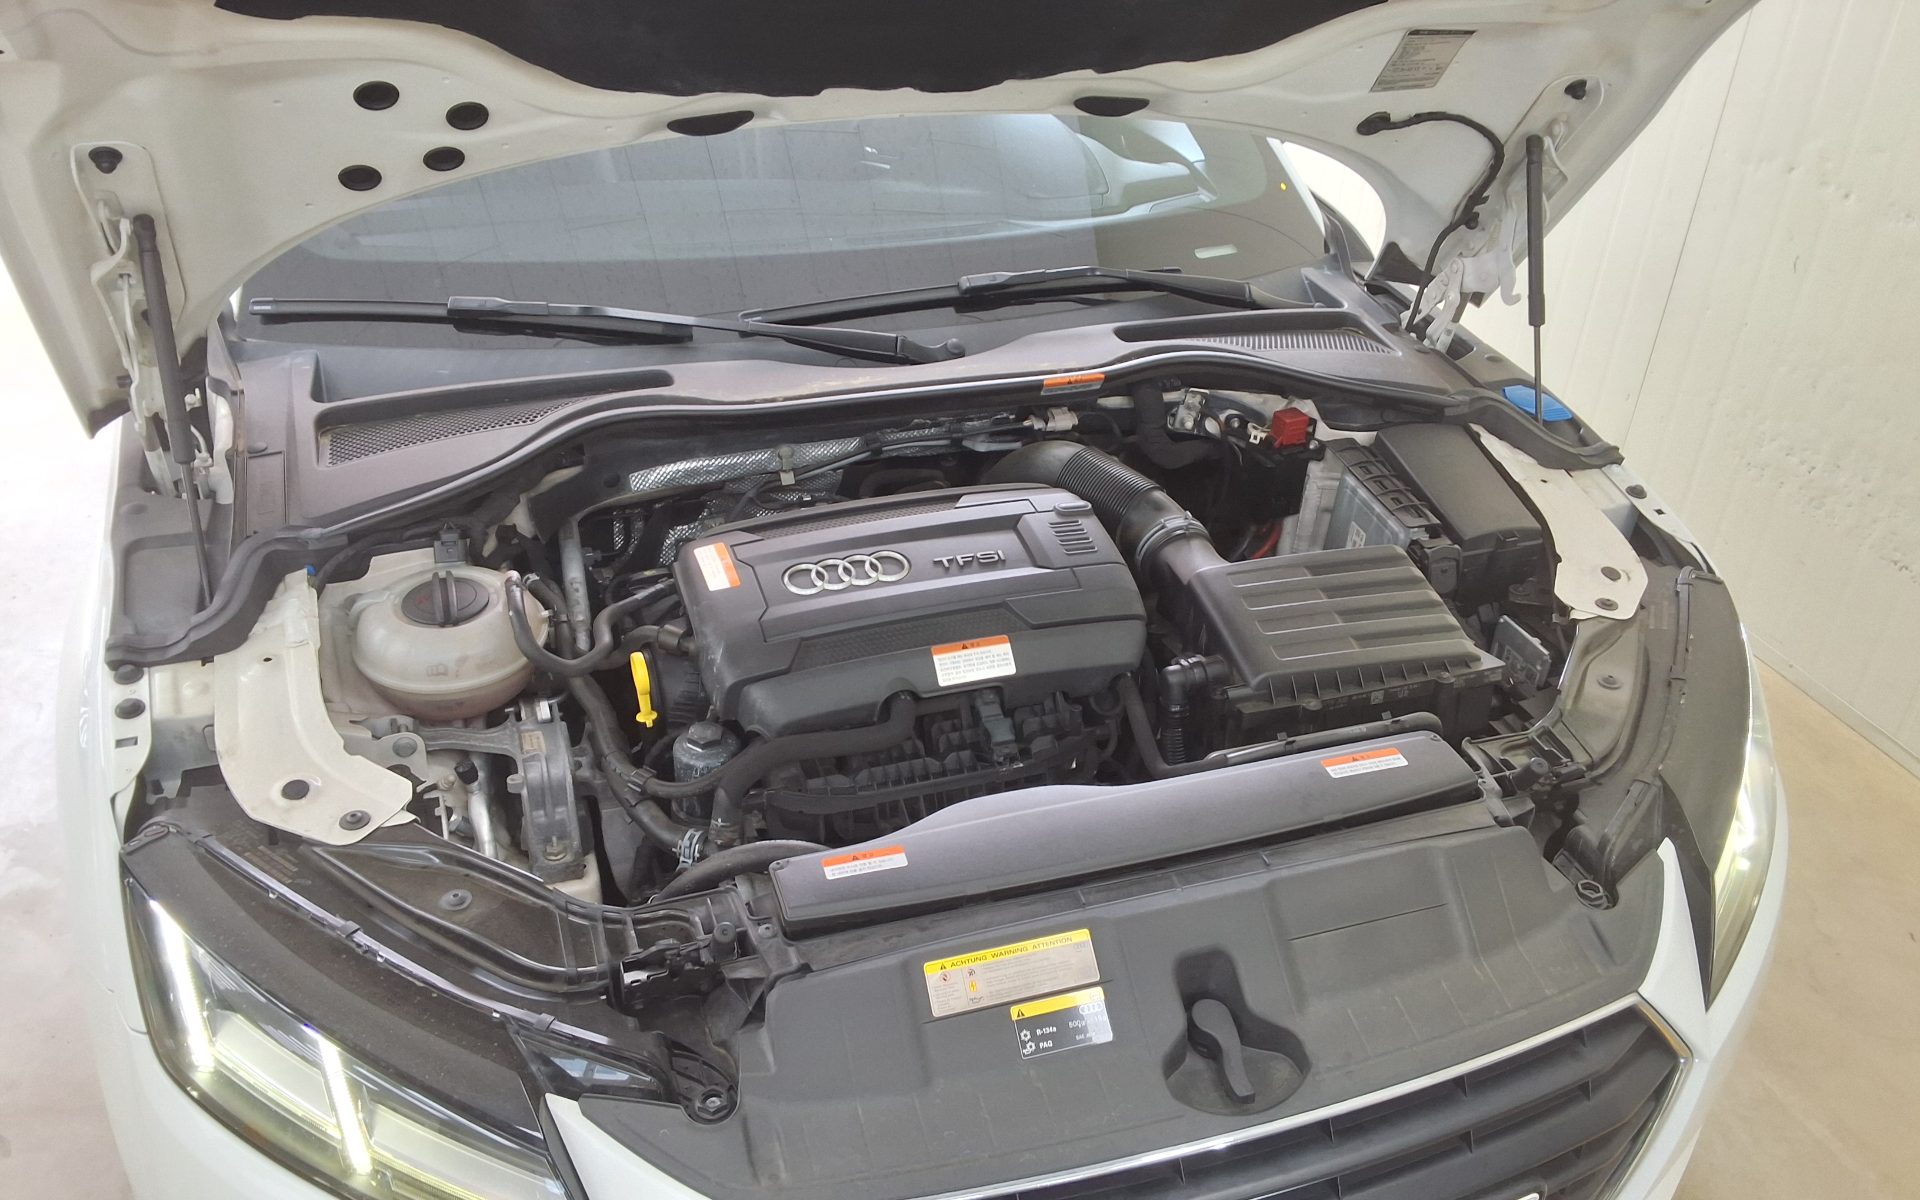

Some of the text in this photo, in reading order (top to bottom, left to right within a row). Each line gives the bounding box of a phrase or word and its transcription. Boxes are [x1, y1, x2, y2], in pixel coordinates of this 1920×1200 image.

[933, 549, 1006, 568] TFSI
[950, 937, 1073, 968] ACHTUNG WARNING ATTENTION
